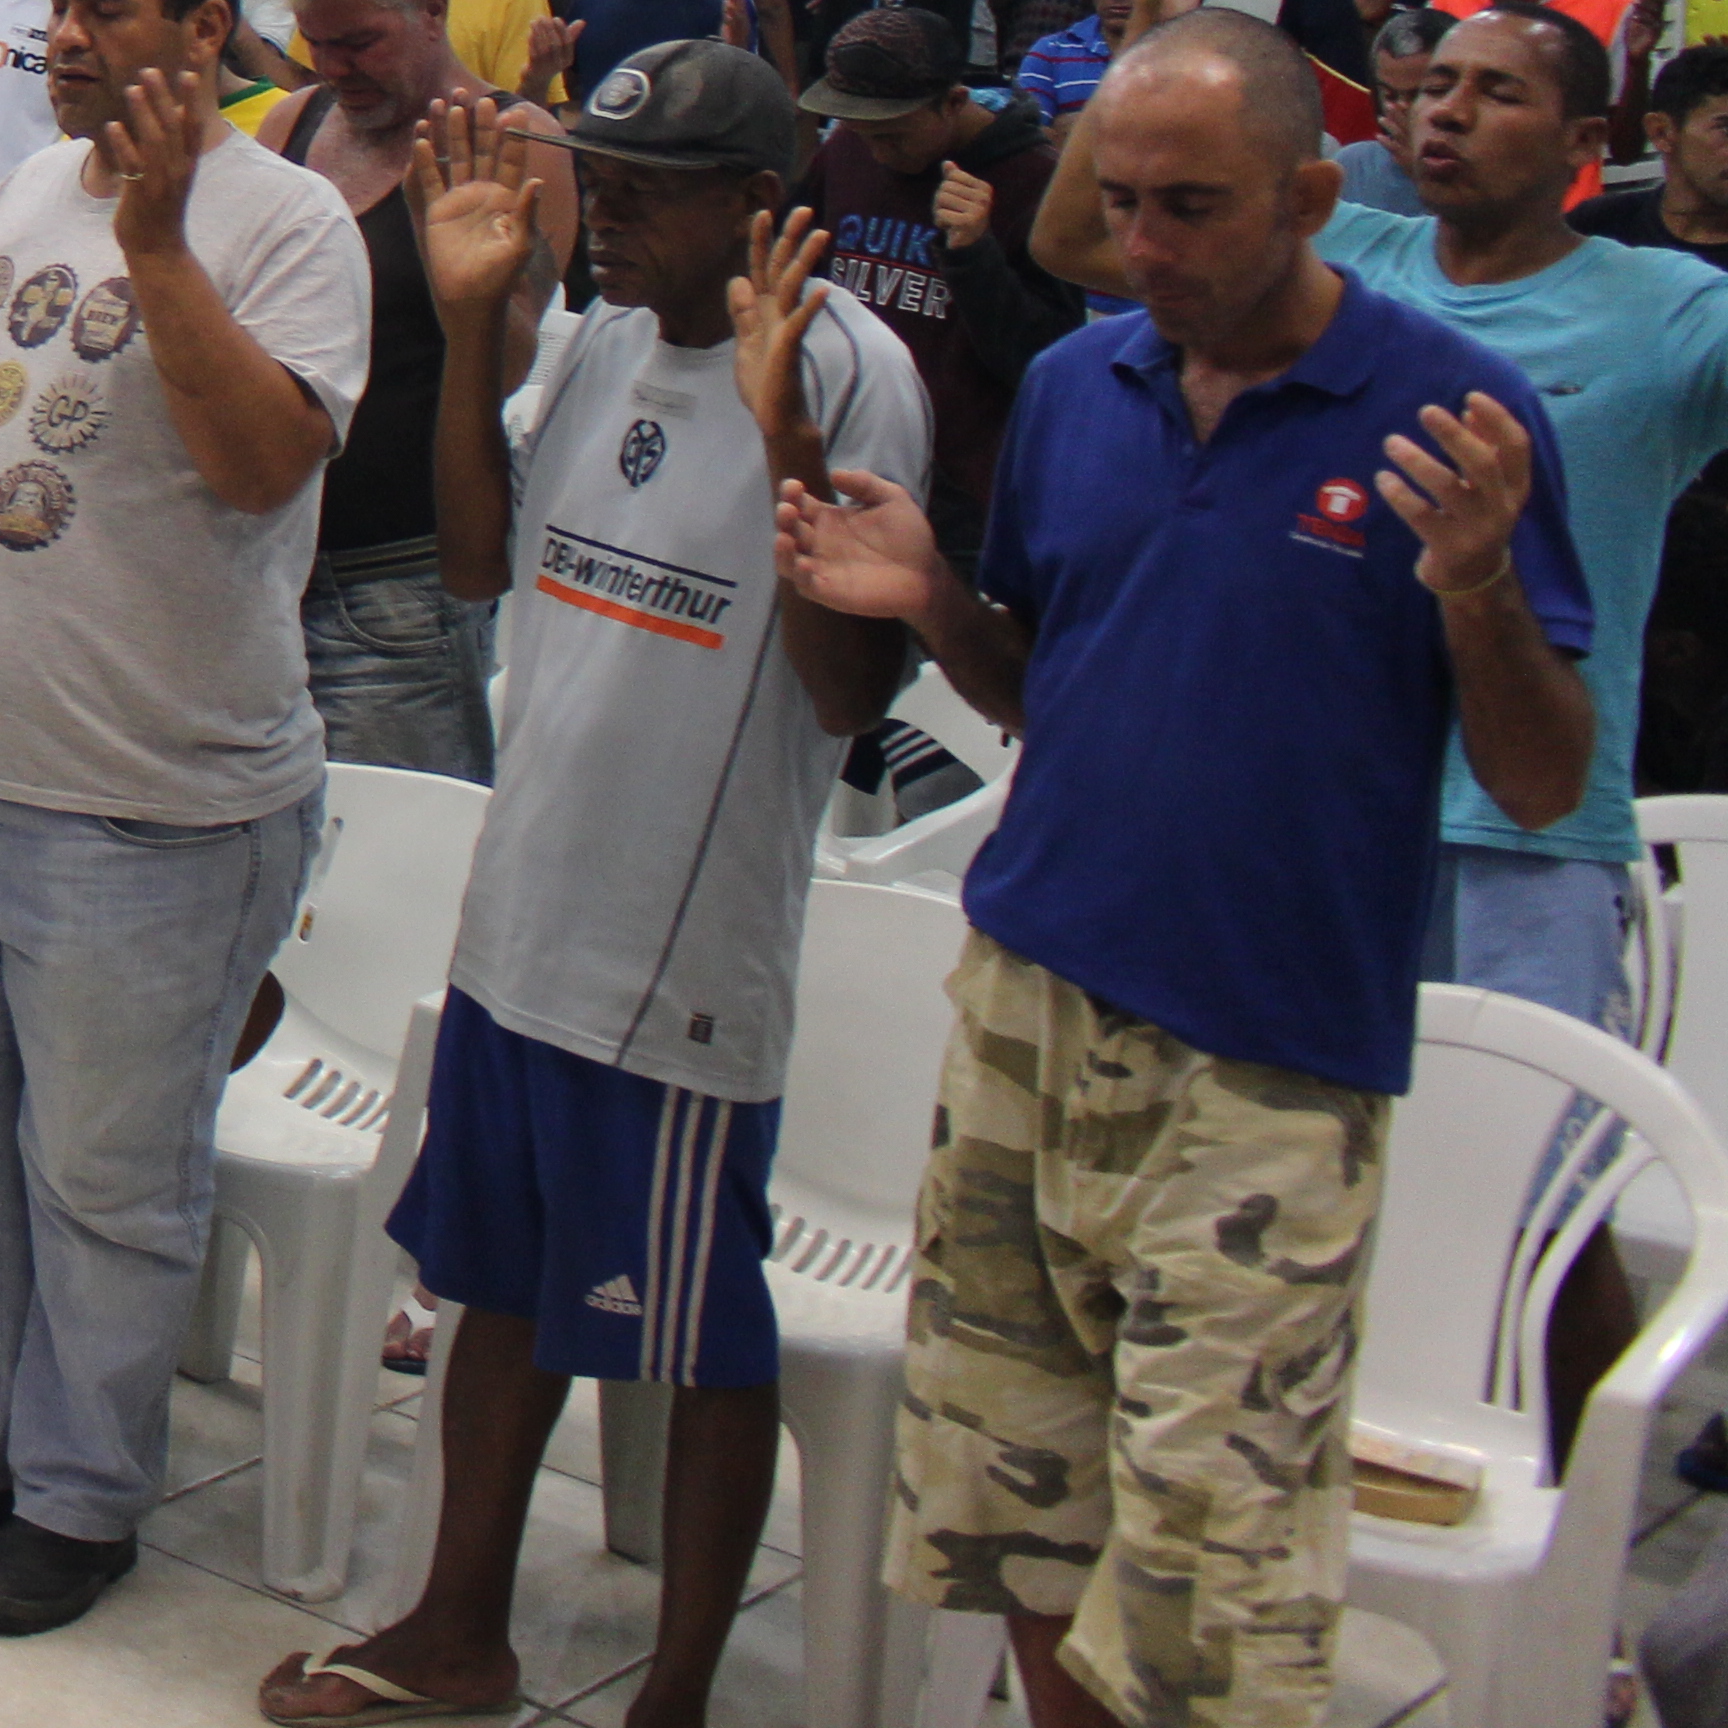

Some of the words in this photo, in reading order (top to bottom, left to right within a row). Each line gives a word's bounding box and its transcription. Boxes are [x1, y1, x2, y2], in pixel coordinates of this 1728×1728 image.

[836, 214, 939, 268] QUIK
[830, 256, 953, 319] SILVER
[584, 1294, 643, 1316] adidas
